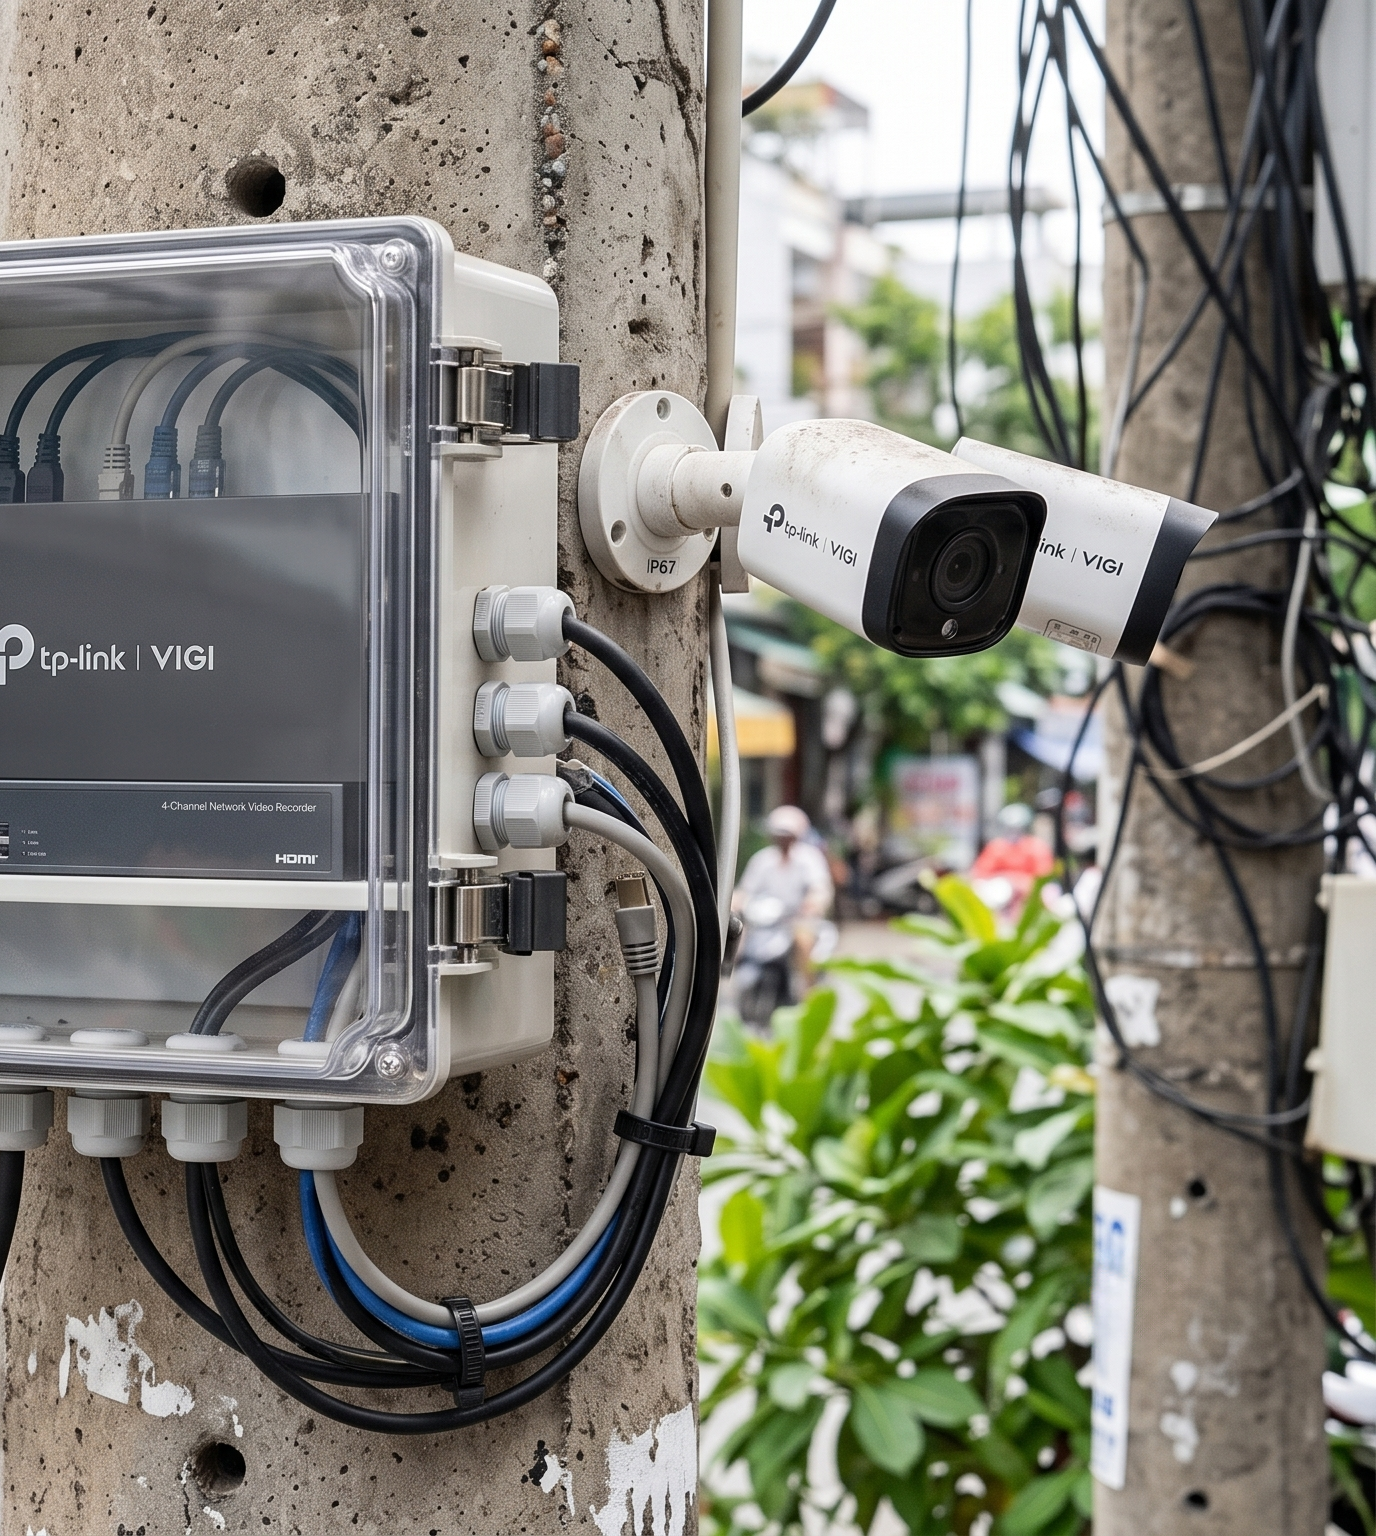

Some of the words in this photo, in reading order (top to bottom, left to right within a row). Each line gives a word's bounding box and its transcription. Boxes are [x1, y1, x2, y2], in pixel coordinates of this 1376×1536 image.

[784, 520, 819, 549] tp-link
[830, 540, 858, 567] VIGI
[646, 559, 676, 574] IP67
[1082, 550, 1124, 576] VIGI
[39, 643, 126, 677] tp-link
[150, 644, 214, 671] VIGI
[161, 801, 208, 812] 4-Channel
[209, 801, 247, 812] Network
[248, 802, 274, 812] Video
[276, 802, 317, 813] Recorder
[275, 853, 316, 865] HDMI
